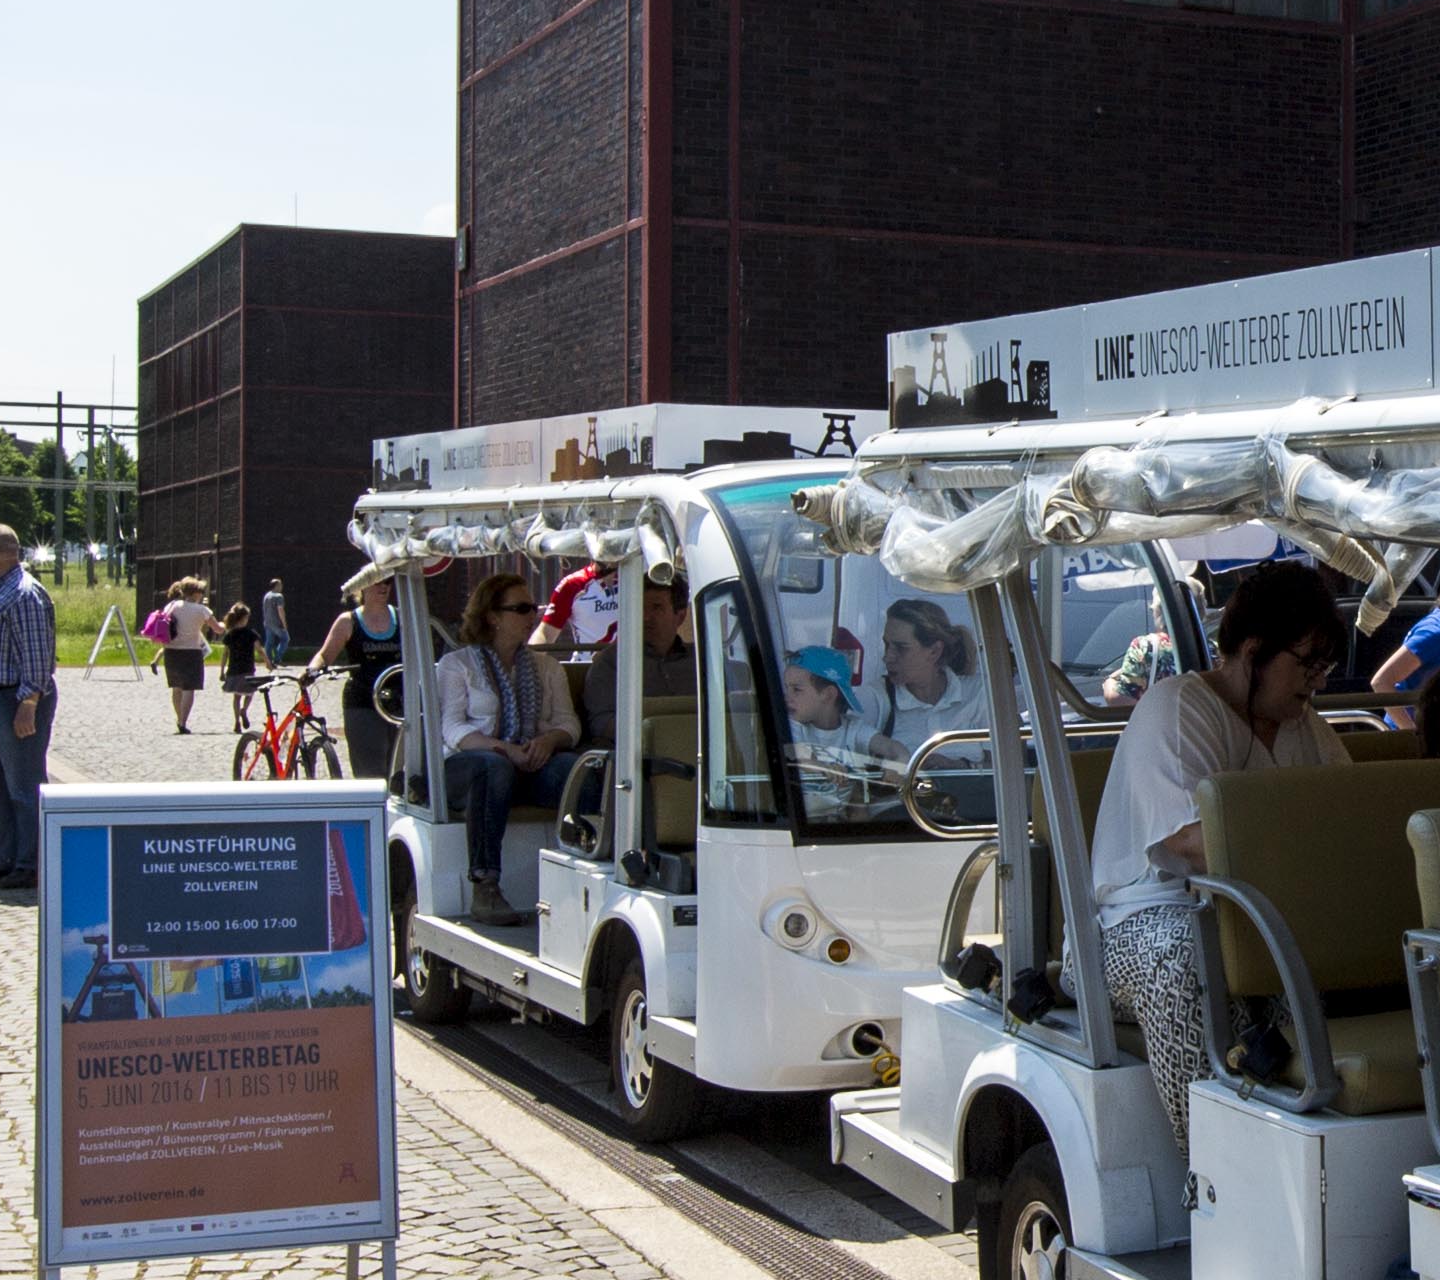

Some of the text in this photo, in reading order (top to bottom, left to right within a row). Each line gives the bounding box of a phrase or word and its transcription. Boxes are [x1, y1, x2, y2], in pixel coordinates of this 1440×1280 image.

[1095, 295, 1406, 382] LINIE UNESCO-WELTERBE ZOLLVEREIN
[144, 834, 296, 855] KUNSTFÜHRUNG
[142, 859, 299, 875] LINIE UNESCO-WELTERBE
[183, 880, 259, 893] ZOLLVEREIN
[146, 917, 298, 933] 12:00 15:00 16:00 17:00
[78, 1043, 320, 1080] UNESCO-WELTERBETAG
[78, 1085, 94, 1110] 5.
[103, 1083, 143, 1108] JUNI
[151, 1080, 193, 1105] 2016
[214, 1077, 233, 1099] 11
[241, 1073, 270, 1098] BIS
[277, 1071, 297, 1094] 19
[304, 1069, 339, 1093] UHR
[79, 1123, 164, 1139] Kunstführungen
[172, 1118, 231, 1132] Kunstrallye
[240, 1111, 325, 1126] Mitmachaktionen
[79, 1136, 154, 1152] Ausstellungen
[163, 1130, 256, 1147] Bühnenprogramm
[265, 1123, 319, 1139] Führungen
[321, 1123, 335, 1133] im
[79, 1151, 149, 1167] Denkmalpfad
[229, 1140, 284, 1154] Live-Musik
[80, 1186, 205, 1207] www.zollverein.de
